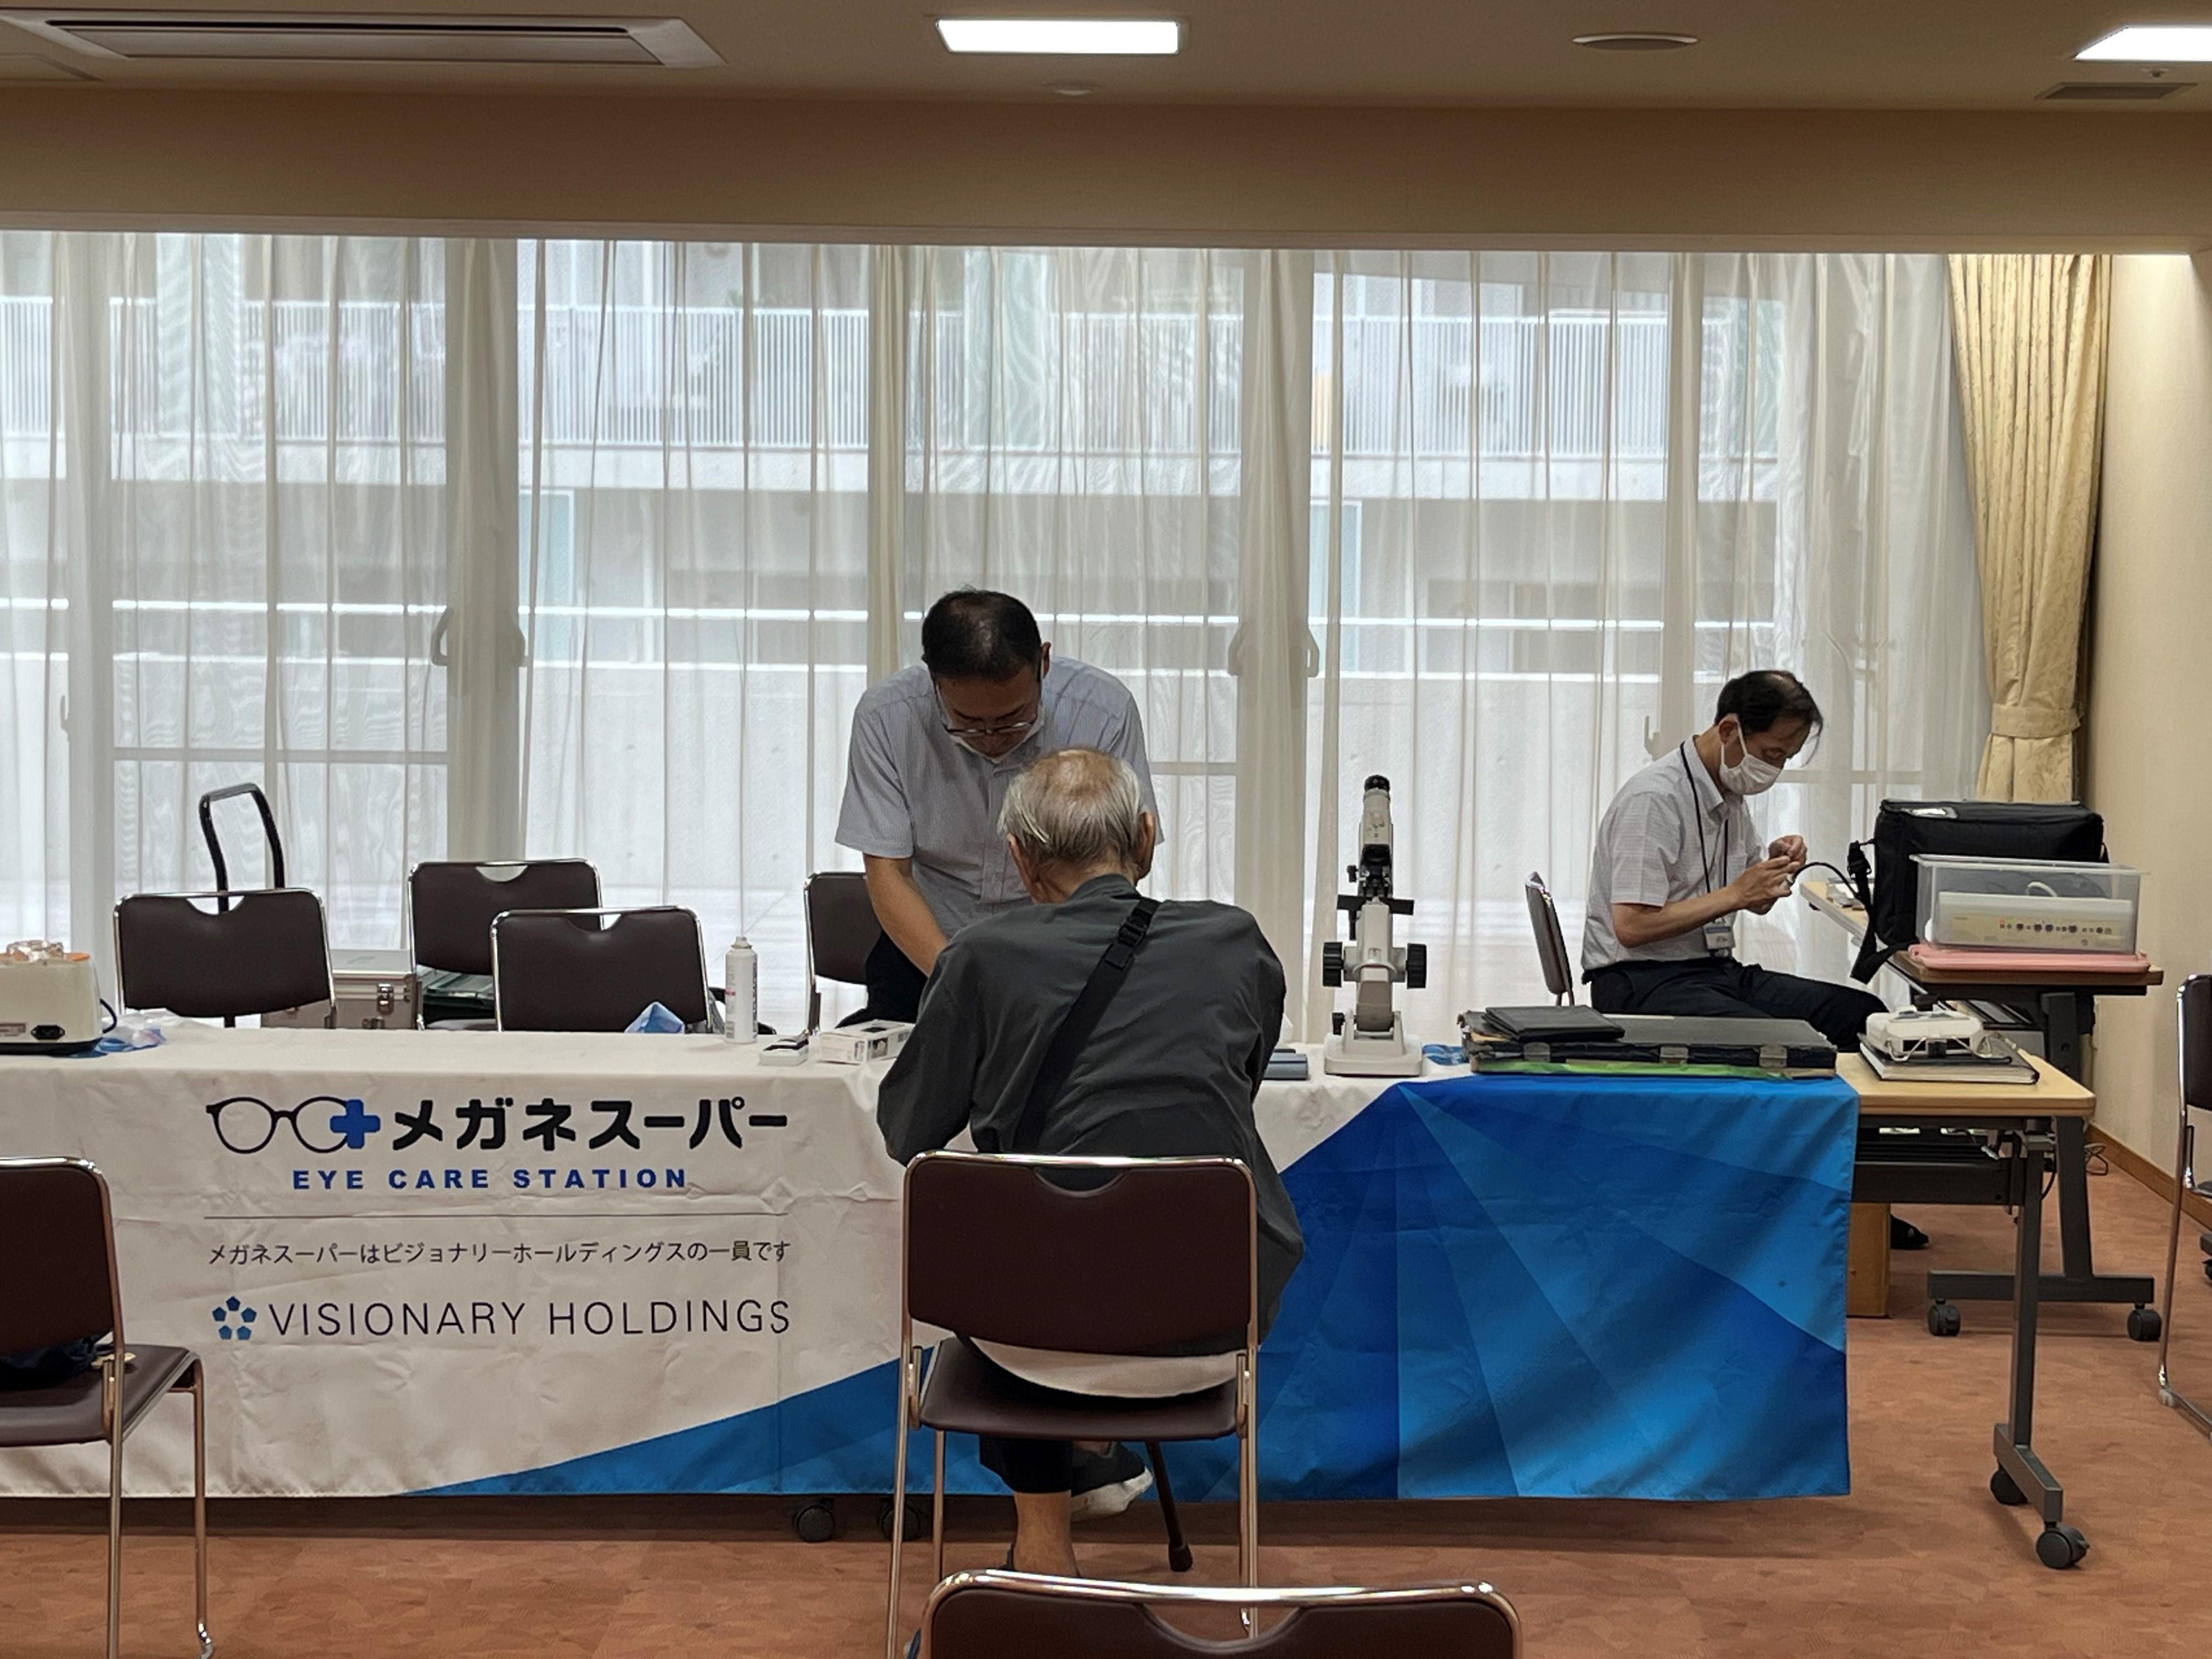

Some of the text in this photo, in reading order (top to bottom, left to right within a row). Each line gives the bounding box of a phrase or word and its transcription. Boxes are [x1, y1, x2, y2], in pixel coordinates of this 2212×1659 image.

[392, 1096, 788, 1151] メガネスーパー
[292, 1169, 686, 1190] EYE CARE STATION
[208, 1239, 792, 1266] メガネスーパーはビジョナリーホールディングスの一員です
[268, 1299, 791, 1336] VISIONARY HOLDINGS
